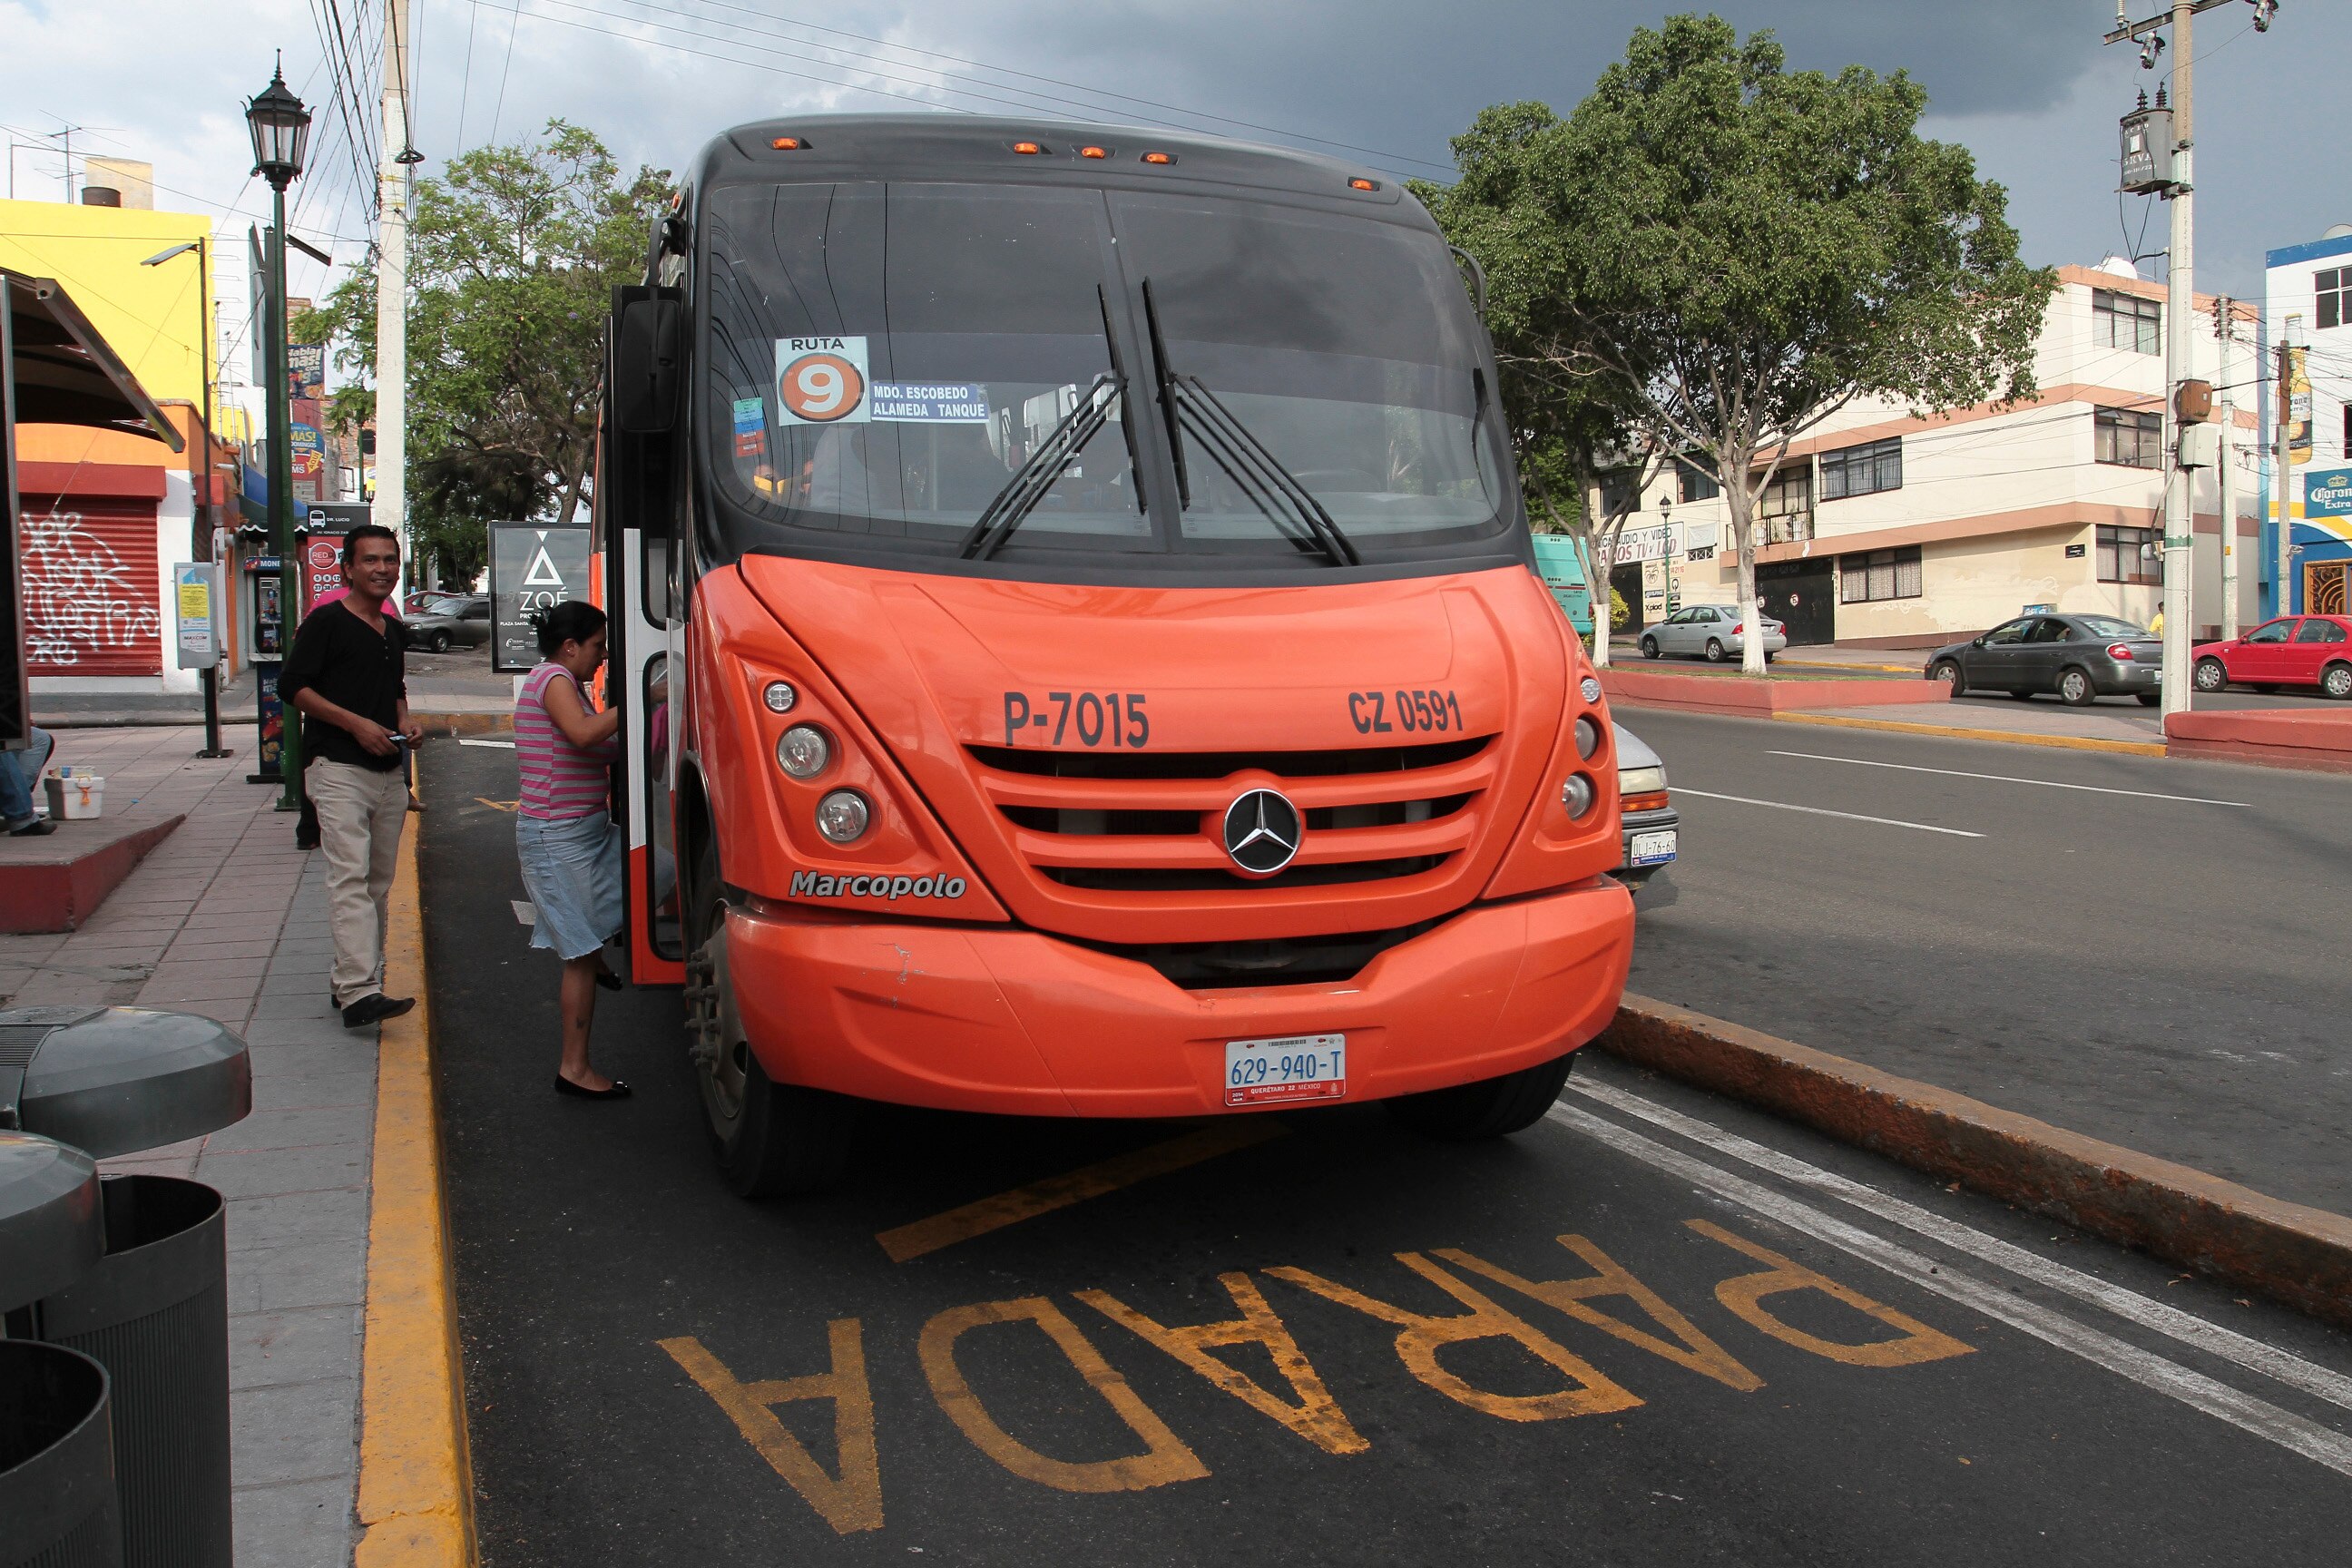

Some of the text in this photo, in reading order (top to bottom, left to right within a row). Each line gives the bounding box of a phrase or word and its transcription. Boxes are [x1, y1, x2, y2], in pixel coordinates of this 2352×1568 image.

[791, 338, 845, 351] RUTA
[798, 363, 844, 413] 9
[874, 386, 904, 398] MDO.
[874, 403, 985, 417] ALAMEDA TANQUE
[2325, 500, 2351, 509] Extra
[1618, 533, 1638, 545] AUDIO
[1642, 531, 1648, 542] Y
[1636, 543, 1649, 559] TV
[519, 586, 569, 611] ZOÉ
[1004, 691, 1150, 749] P-7015
[1348, 690, 1464, 735] CZ 0591
[1633, 839, 1675, 857] ULJ-76-60
[789, 870, 966, 899] Marcopolo
[1231, 1051, 1342, 1085] 629-940-T
[1250, 1084, 1286, 1094] QUERÉTARO
[656, 1219, 1979, 1534] PARADA
